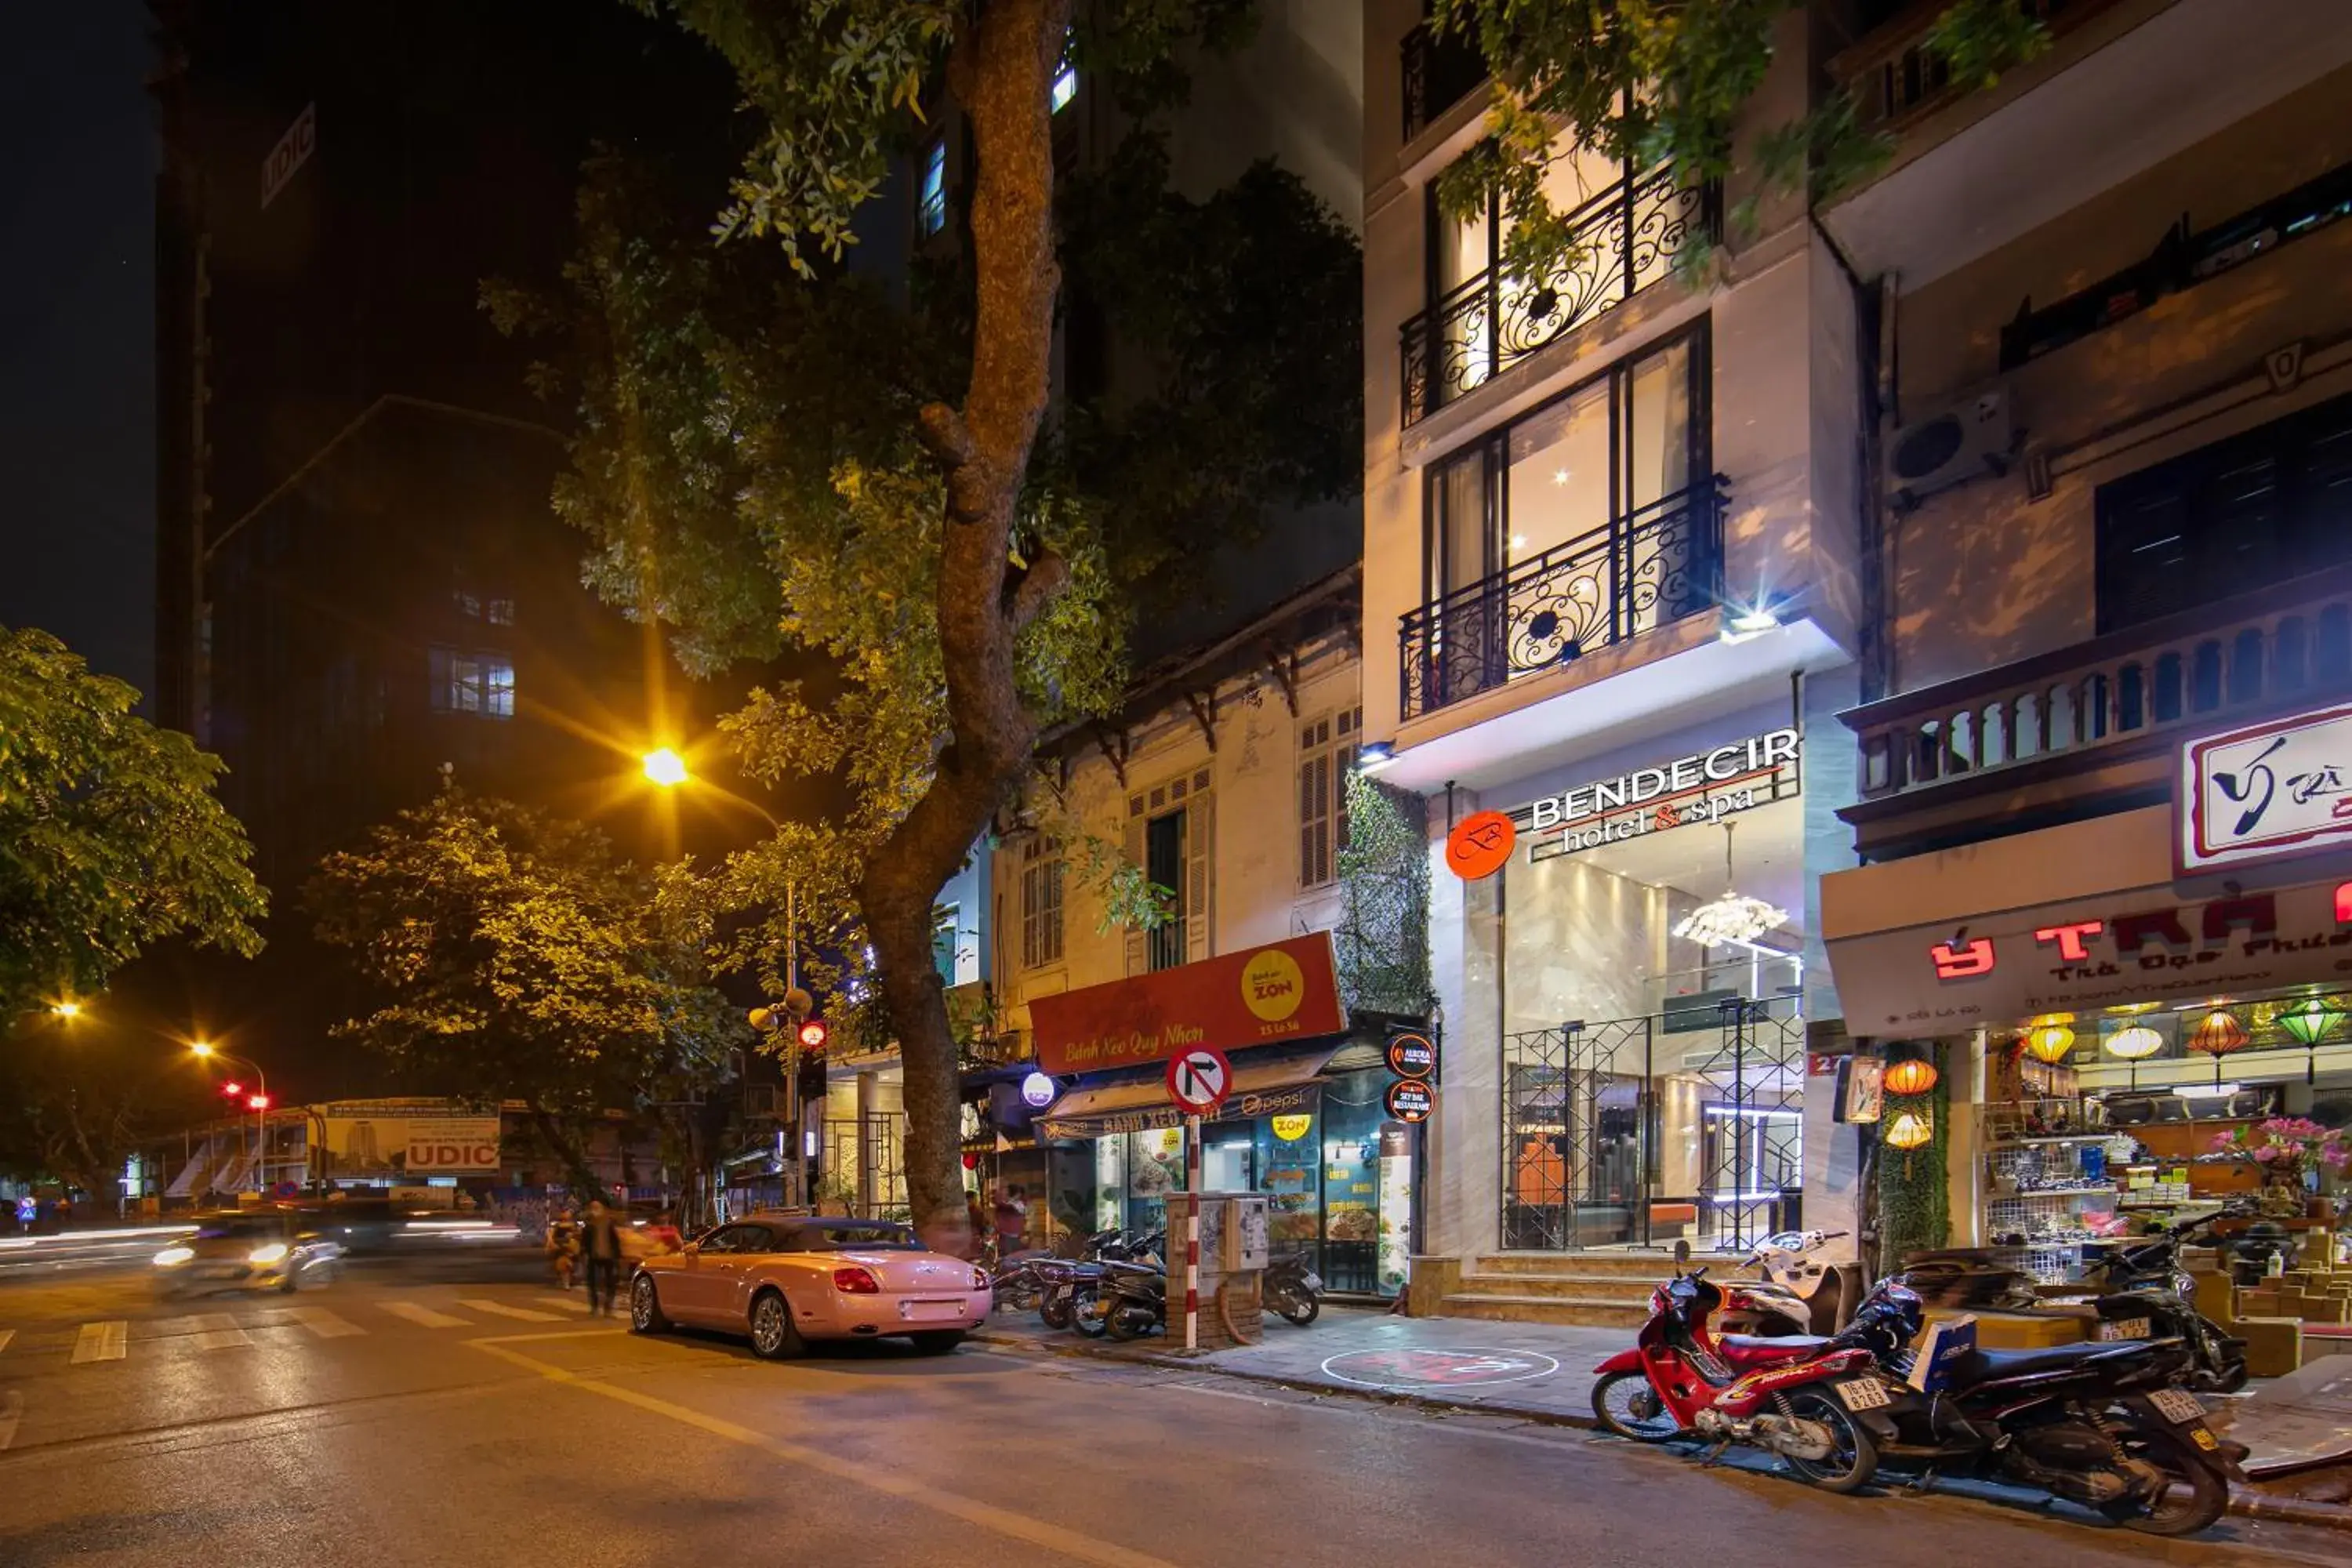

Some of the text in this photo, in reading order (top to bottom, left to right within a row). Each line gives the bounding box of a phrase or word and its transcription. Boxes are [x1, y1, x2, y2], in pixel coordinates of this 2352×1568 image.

[1531, 727, 1798, 830] BENDECIR
[1563, 787, 1755, 852] hotel & spa
[1065, 1039, 1099, 1062] Bánh
[1129, 1030, 1160, 1056] Quy
[1276, 1118, 1305, 1131] ZON
[410, 1145, 495, 1165] UDIC
